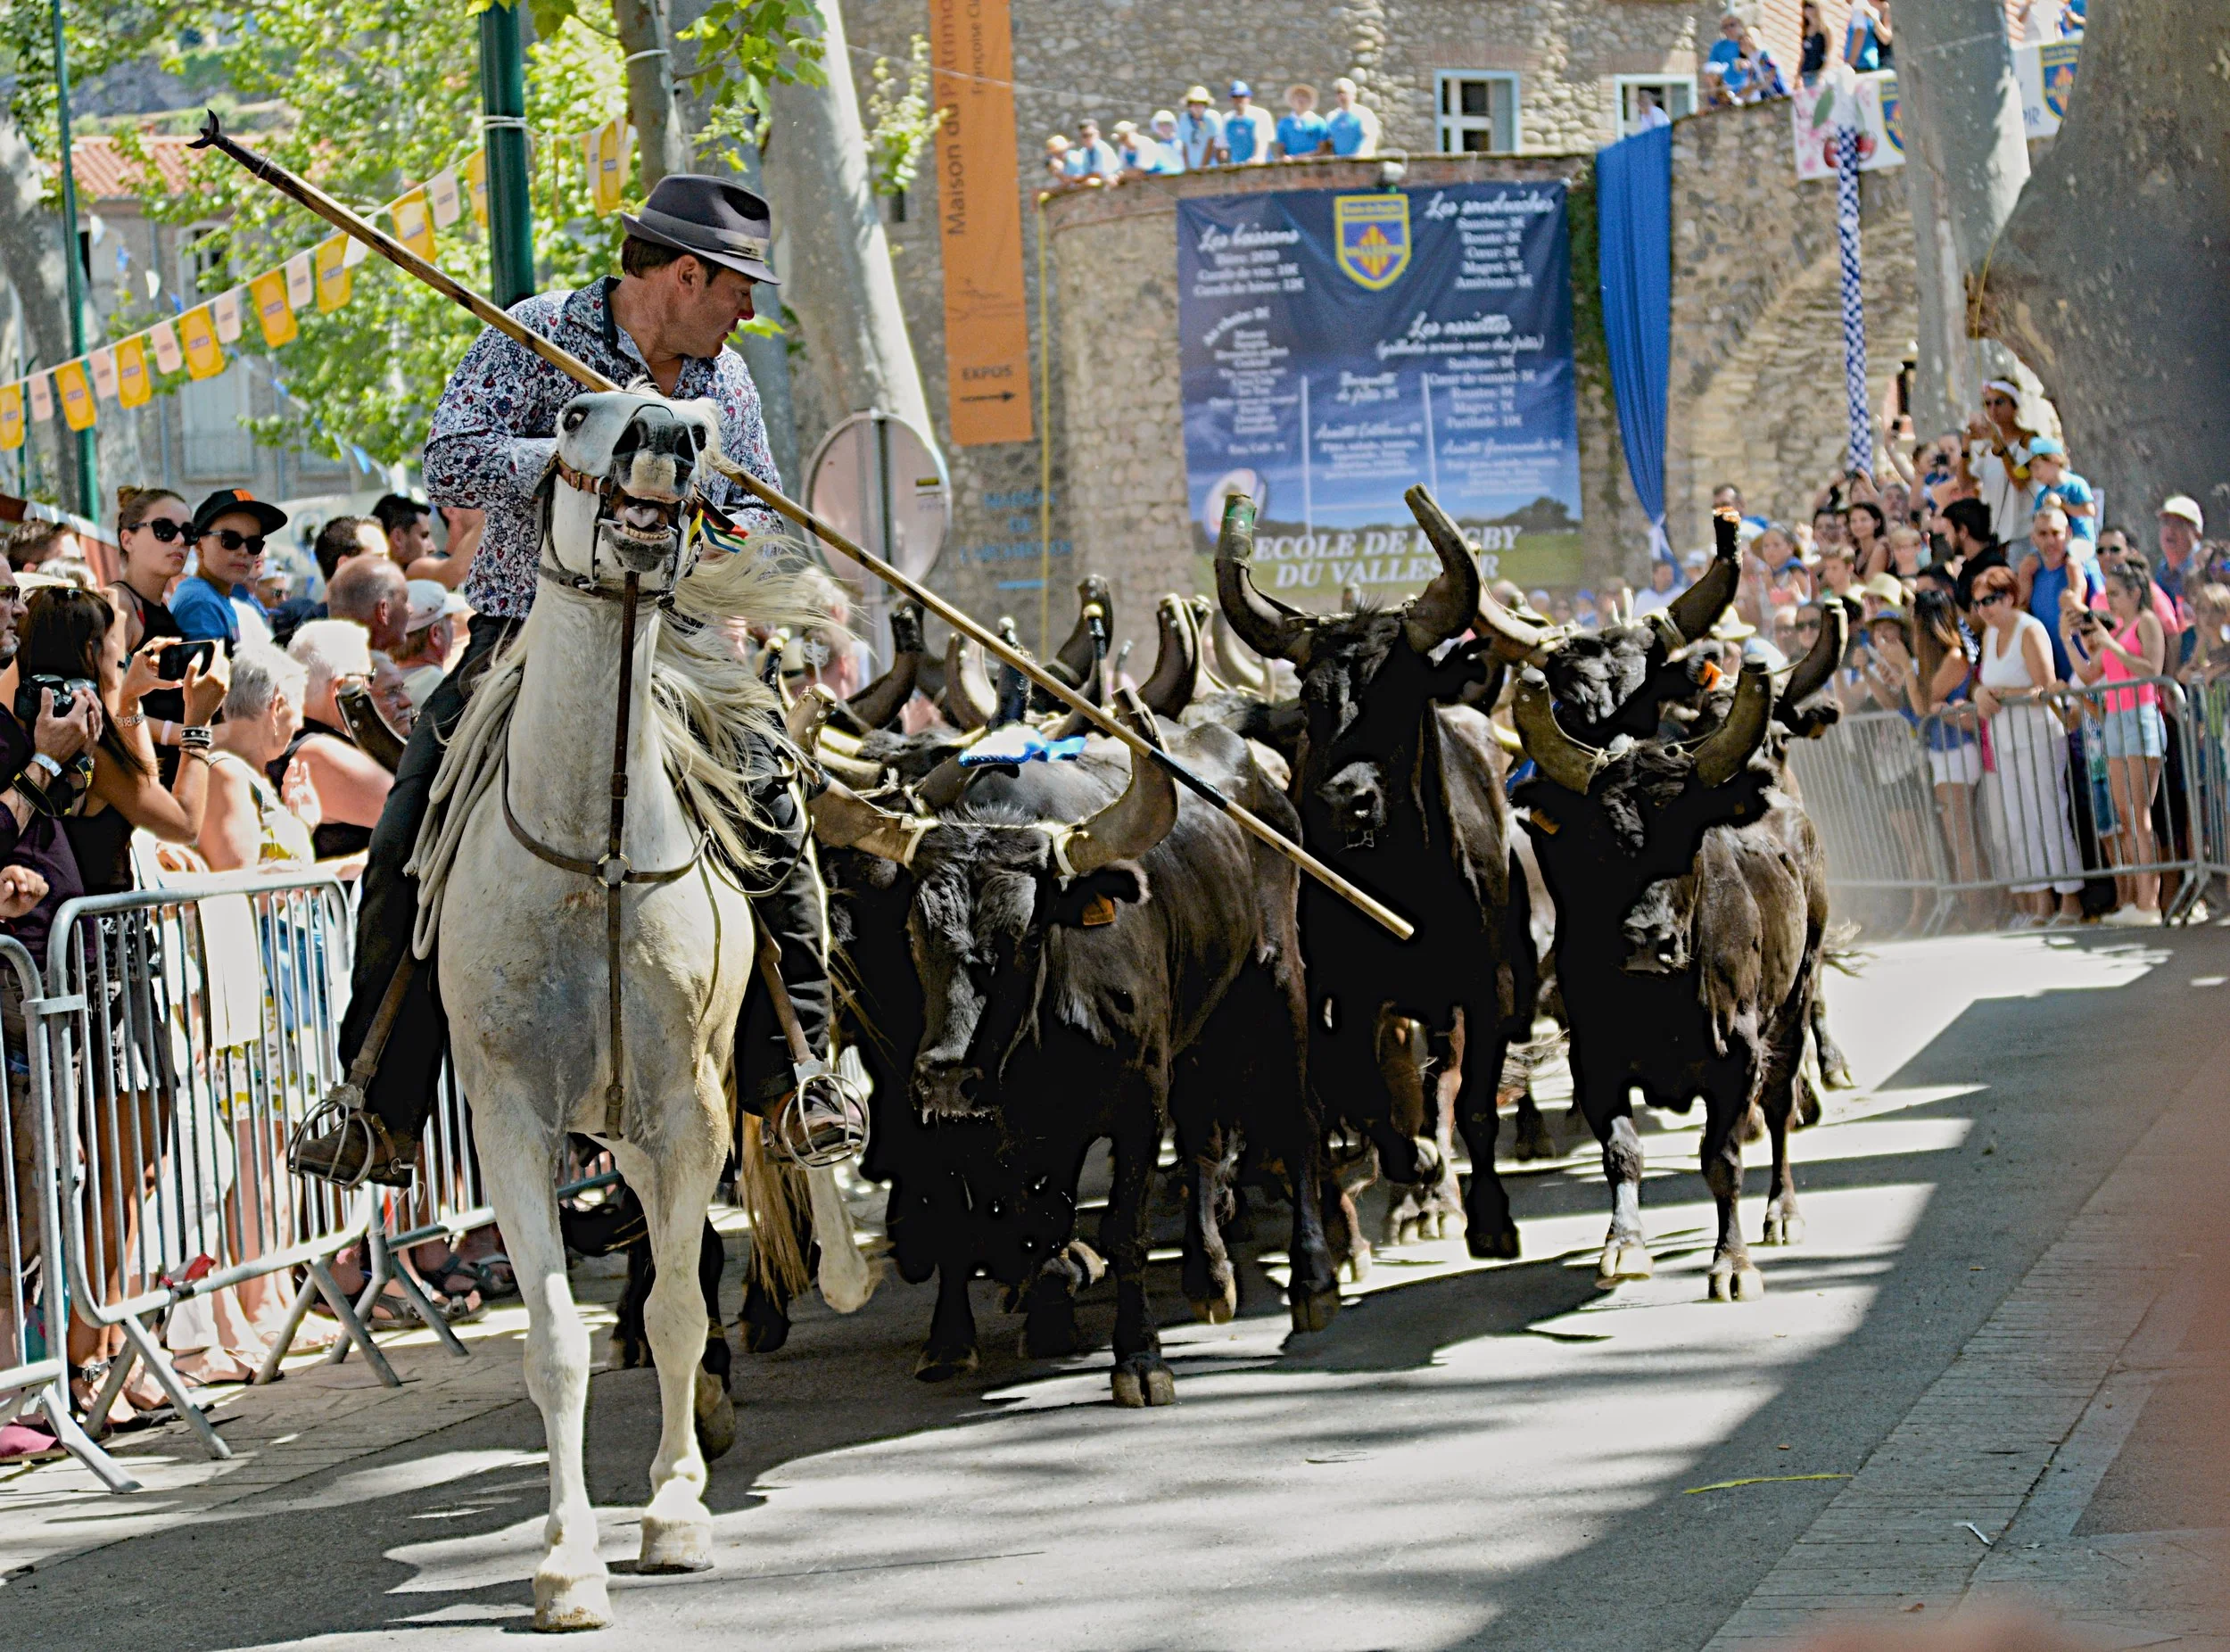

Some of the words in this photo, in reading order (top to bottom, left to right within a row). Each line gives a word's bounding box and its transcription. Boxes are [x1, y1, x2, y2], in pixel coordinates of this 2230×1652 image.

[943, 103, 961, 136] du
[946, 144, 966, 235] Maison
[961, 364, 1013, 382] EXPOS
[1253, 533, 1358, 561] ECOLE
[1362, 530, 1408, 557] DE
[1275, 560, 1323, 589] DU
[1330, 553, 1499, 585] VALLESR
